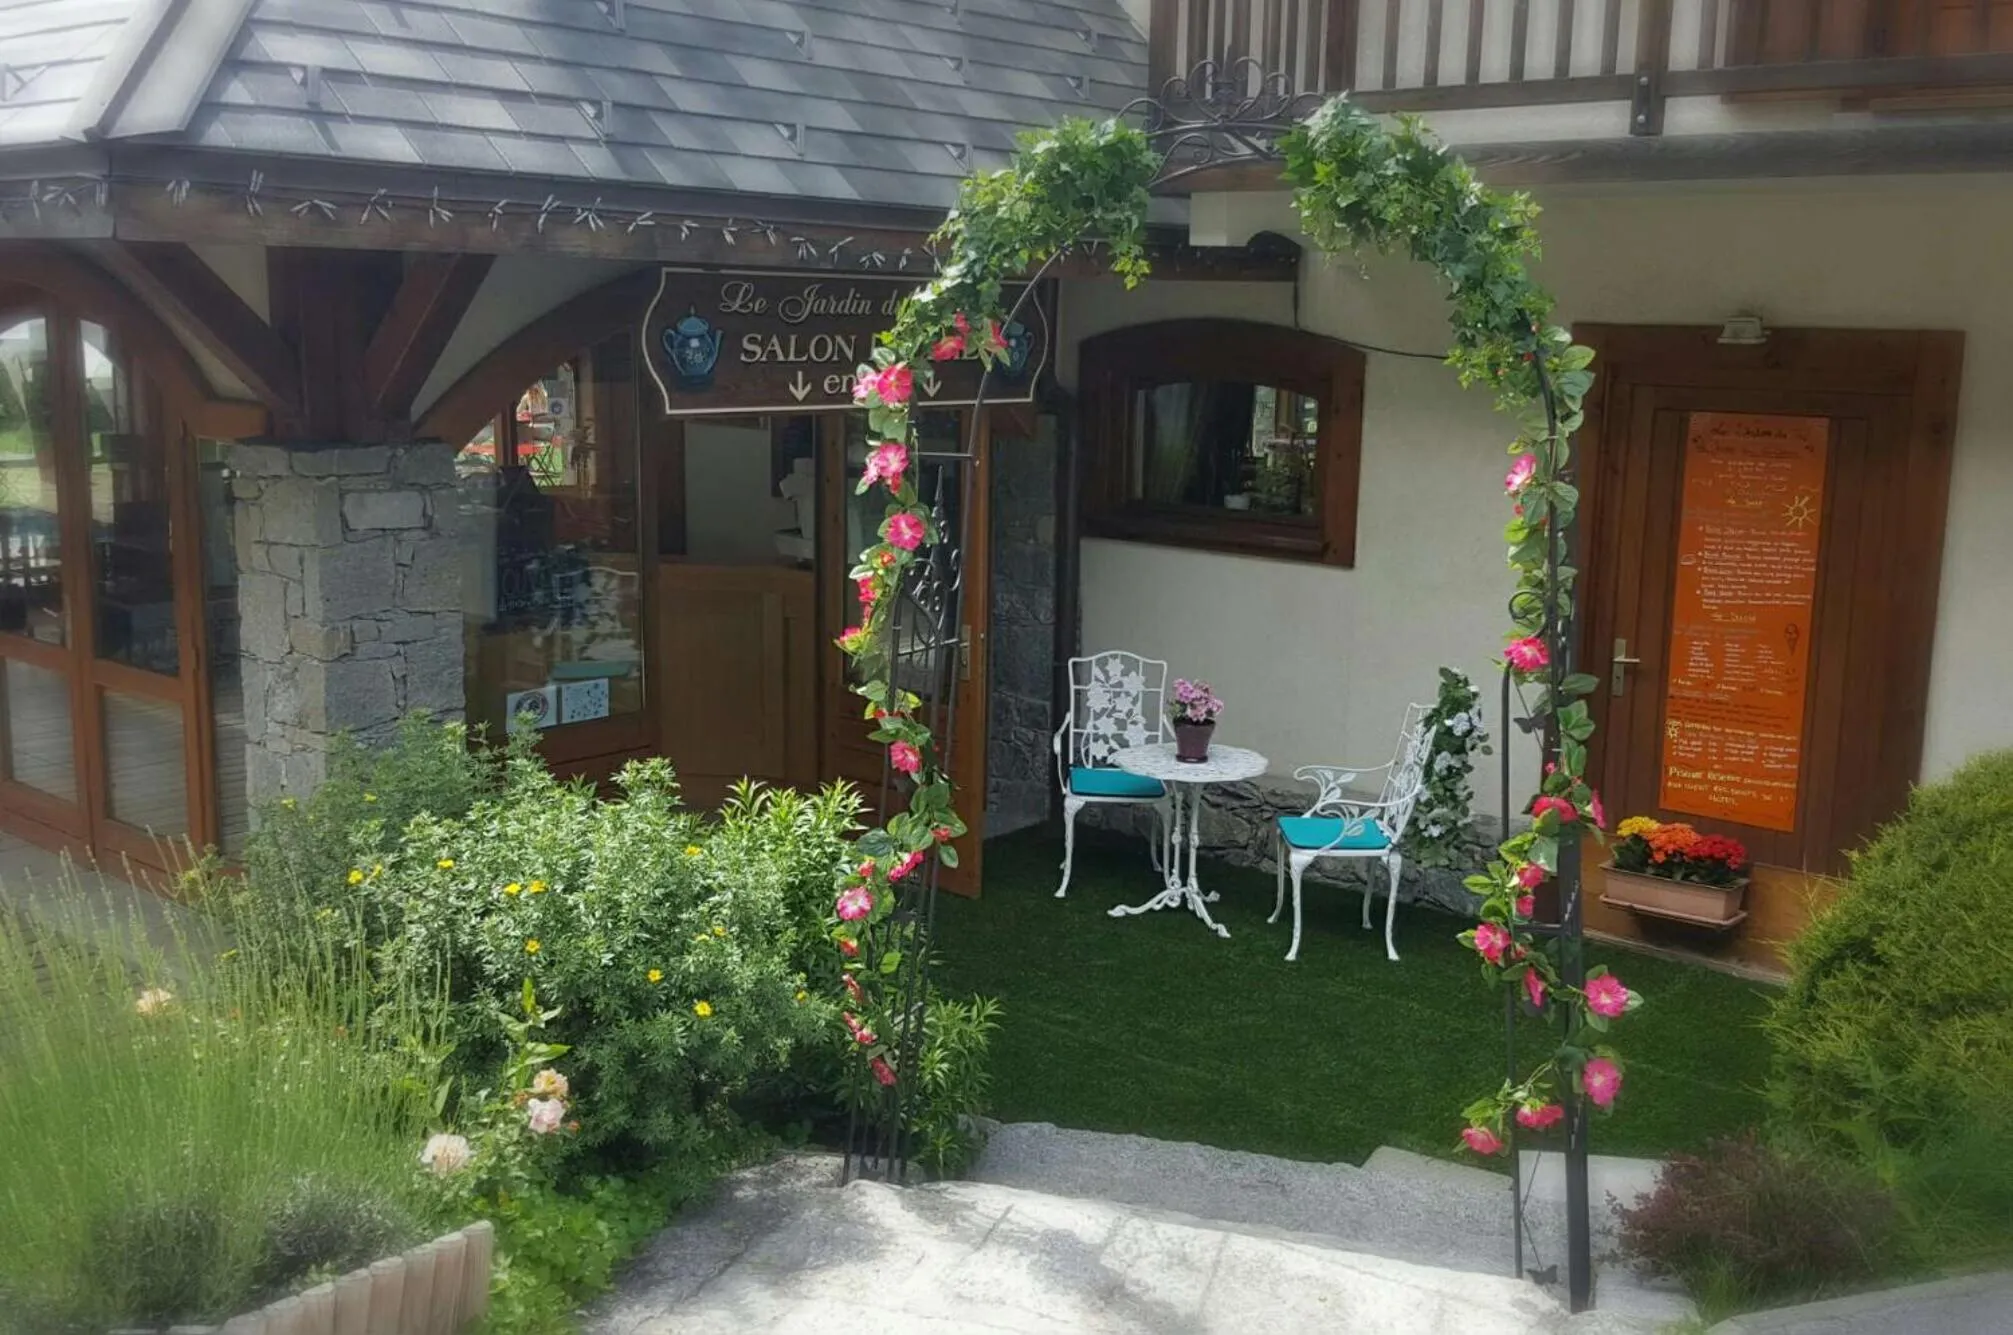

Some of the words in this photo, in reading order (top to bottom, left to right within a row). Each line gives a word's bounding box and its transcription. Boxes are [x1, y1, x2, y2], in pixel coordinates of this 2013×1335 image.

[719, 280, 770, 315] Le
[778, 283, 873, 323] Jardin
[740, 333, 858, 363] SALON
